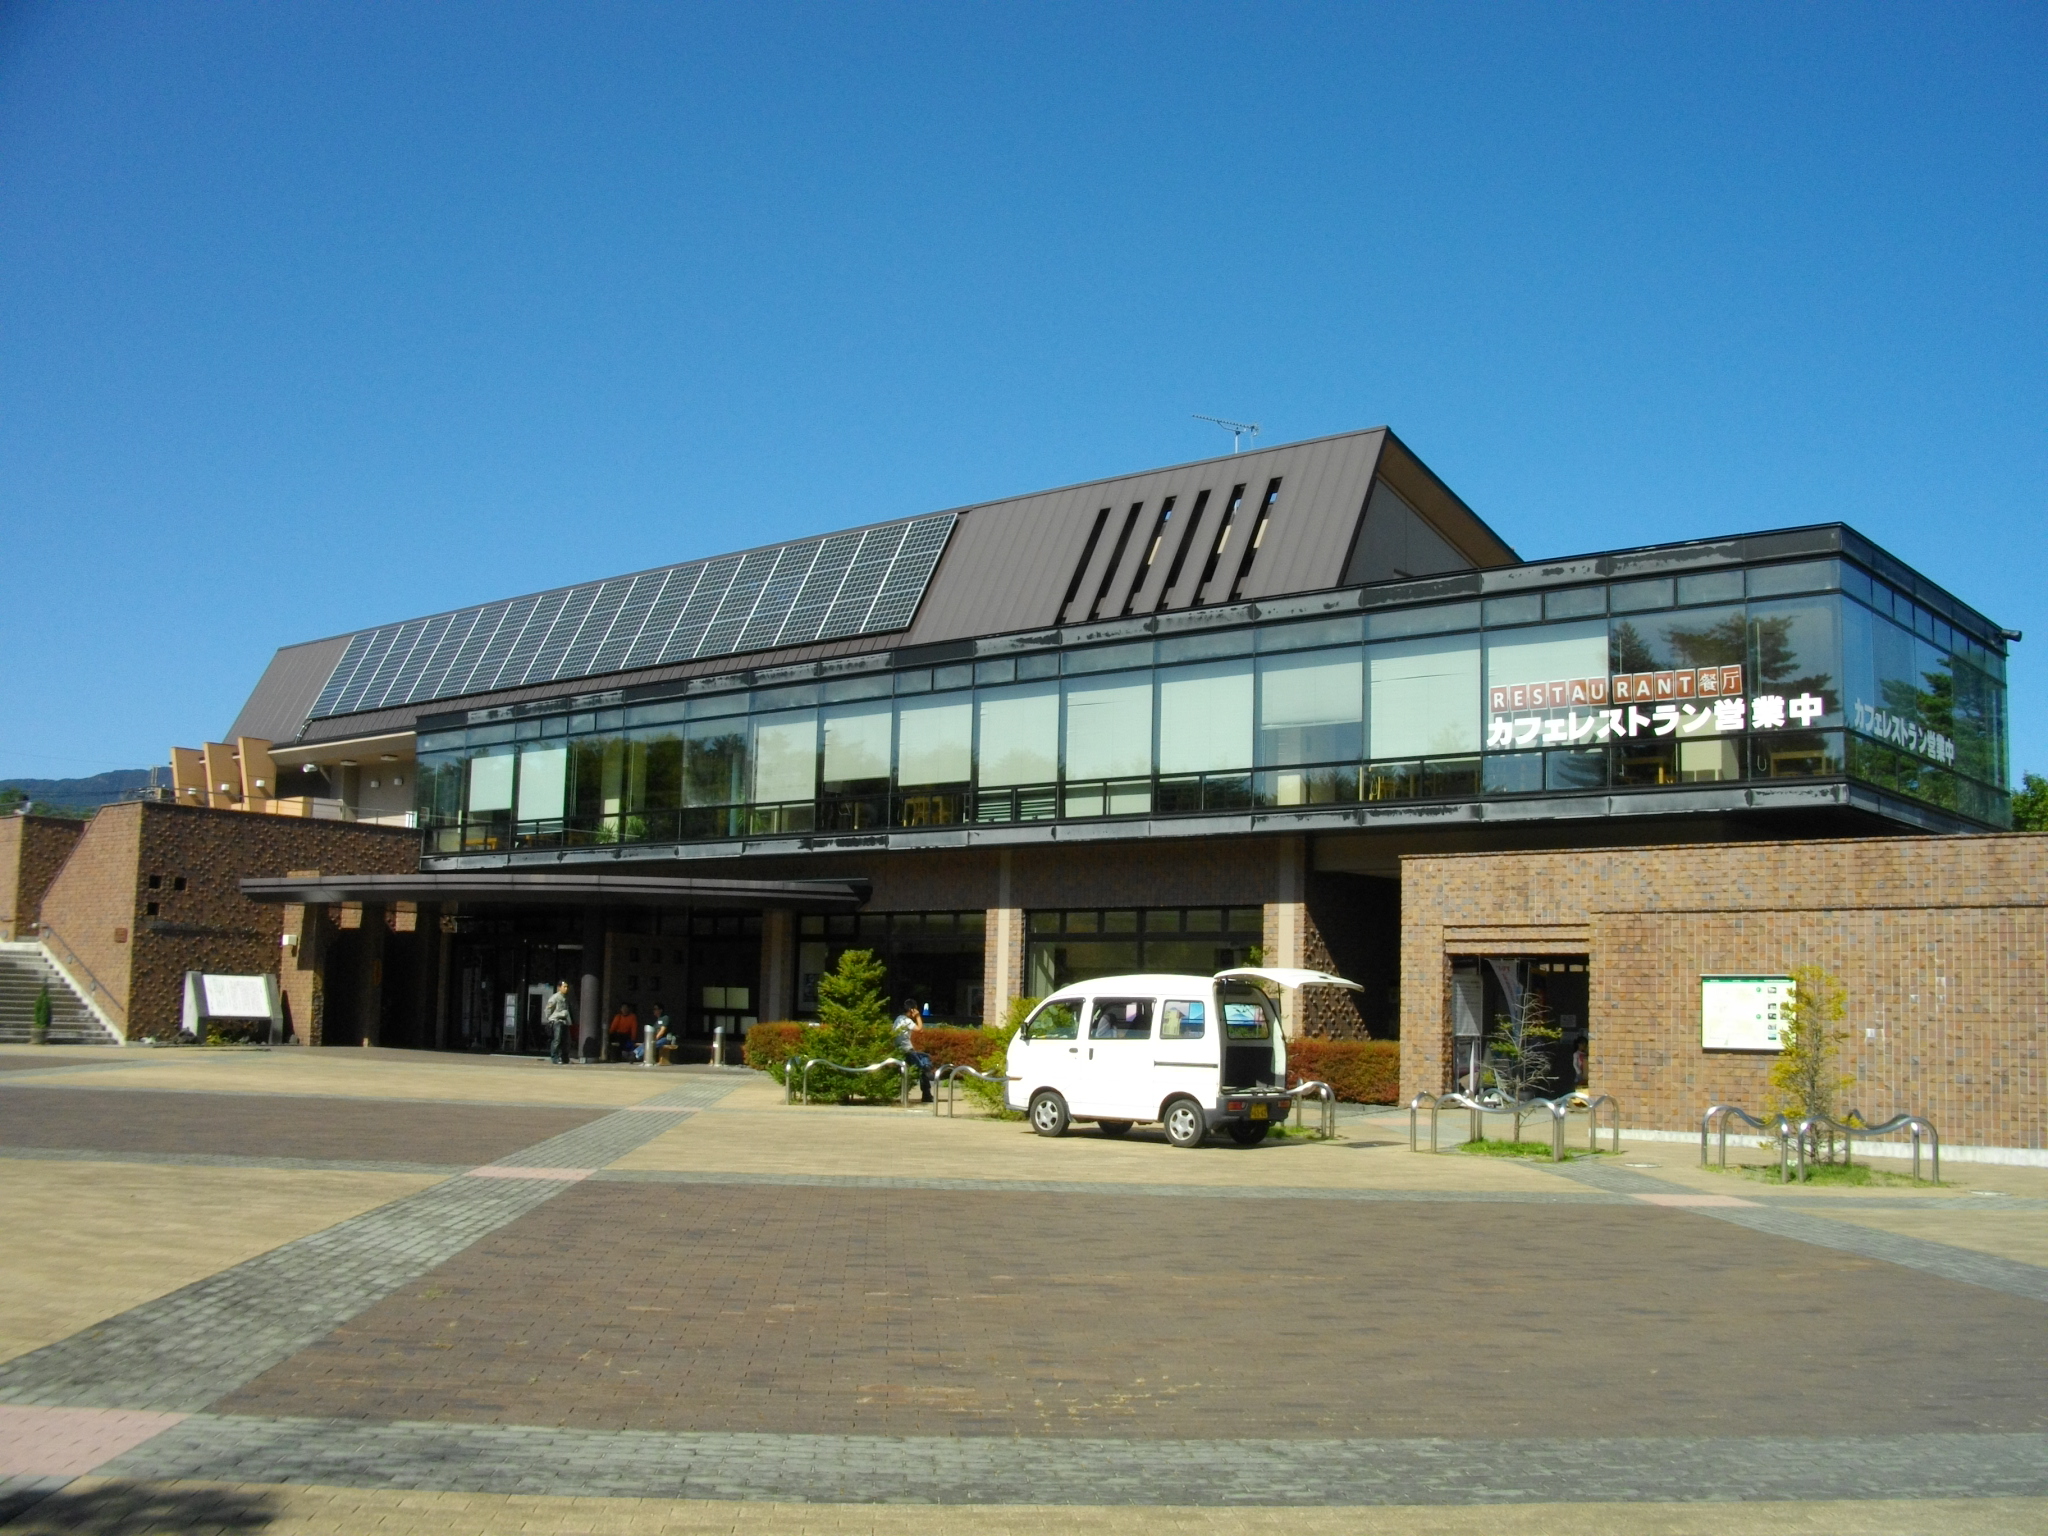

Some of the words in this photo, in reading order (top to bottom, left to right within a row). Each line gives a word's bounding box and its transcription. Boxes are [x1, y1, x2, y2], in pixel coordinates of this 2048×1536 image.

[1493, 675, 1694, 708] RESTAURANT
[1487, 693, 1823, 747] カフェレストラン営業中
[1854, 697, 1955, 767] カフェレストラン営業中
